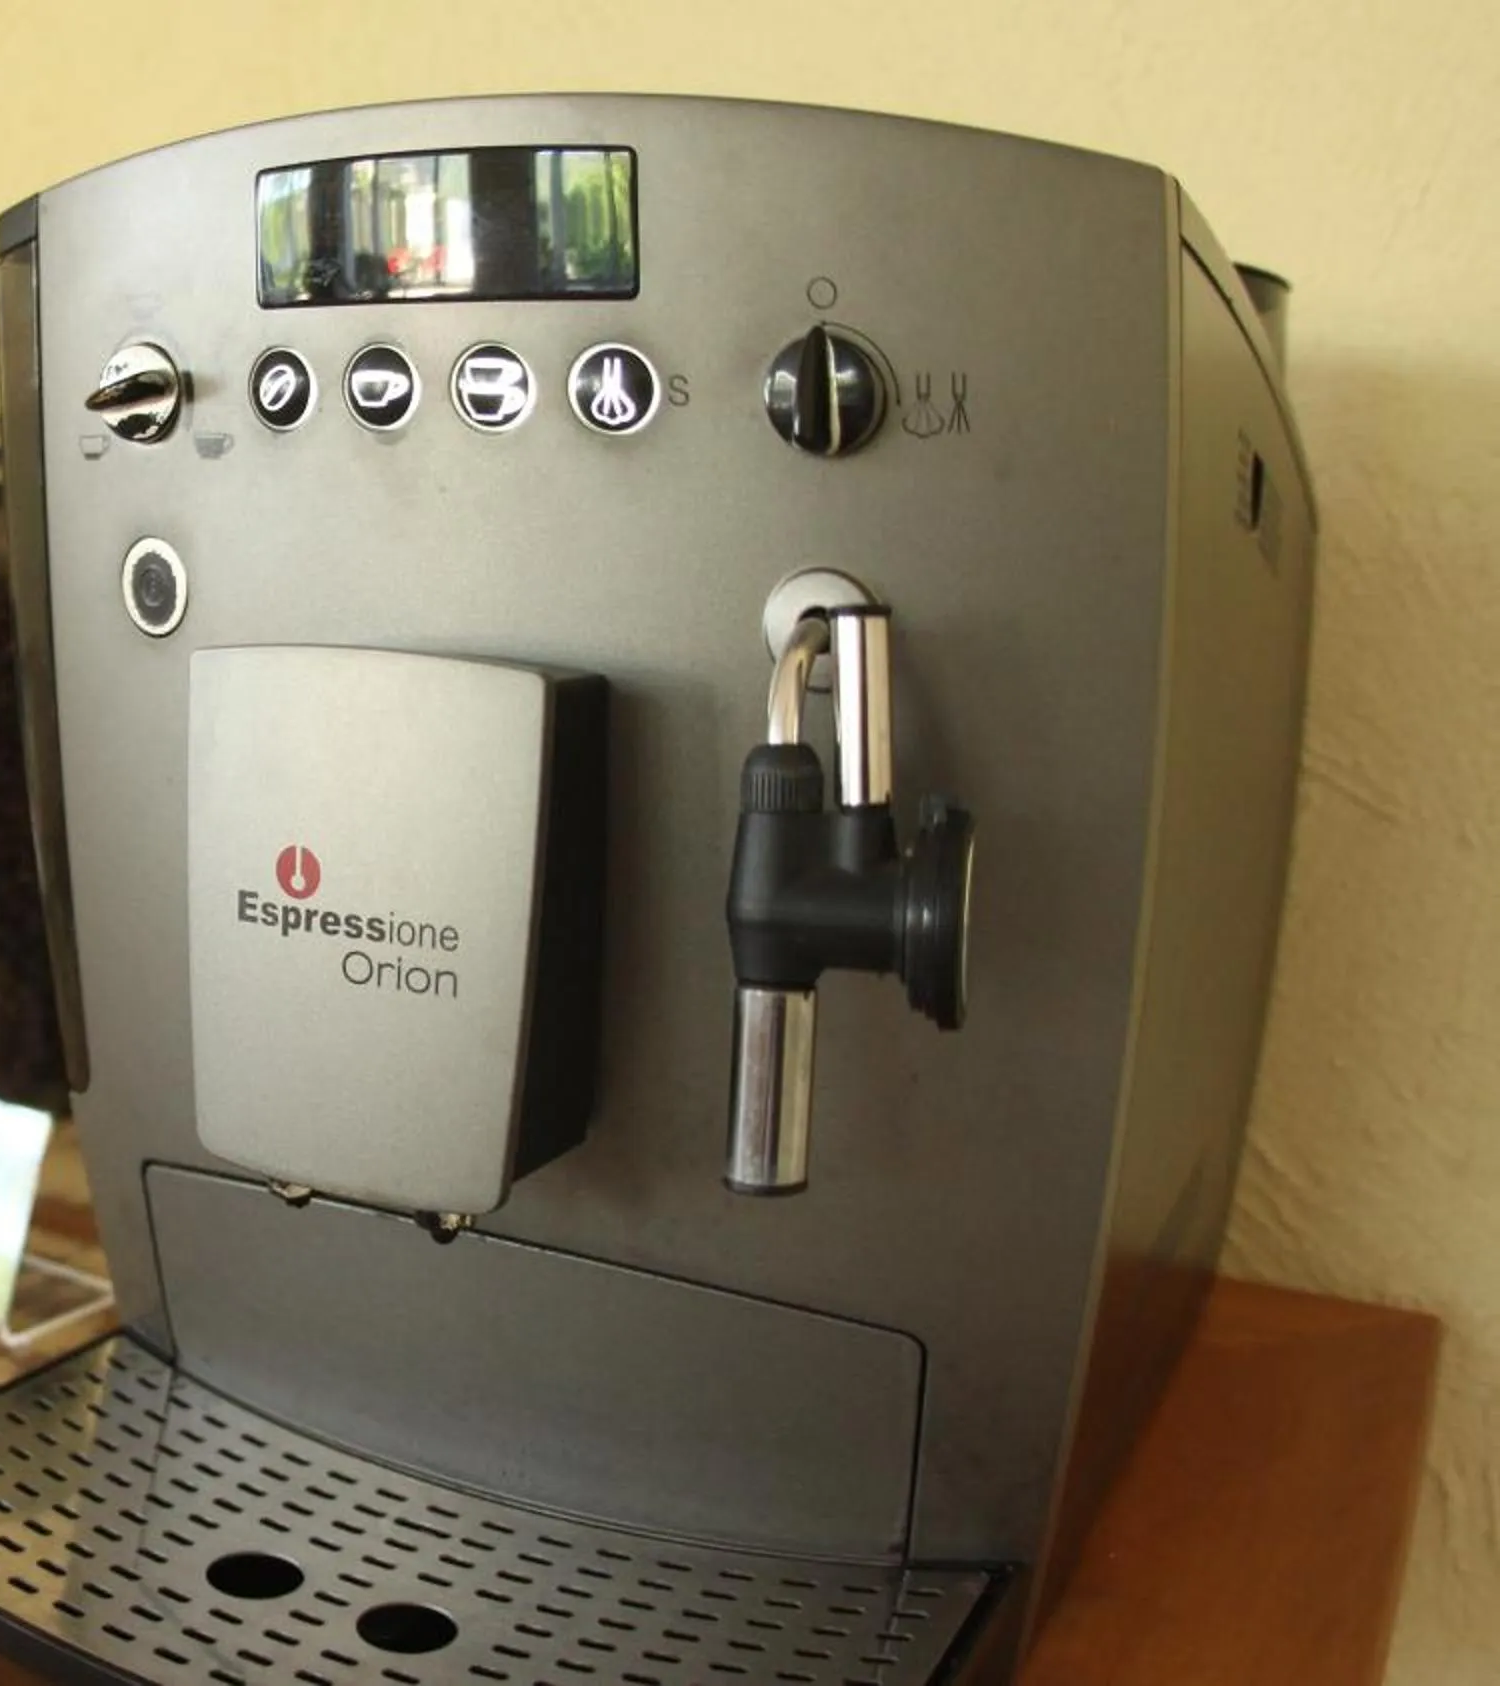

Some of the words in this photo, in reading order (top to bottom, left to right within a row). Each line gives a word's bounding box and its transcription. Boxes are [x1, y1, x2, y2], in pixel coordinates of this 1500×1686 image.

[668, 373, 690, 407] S
[238, 889, 460, 952] Espressione
[342, 950, 458, 998] Orion
